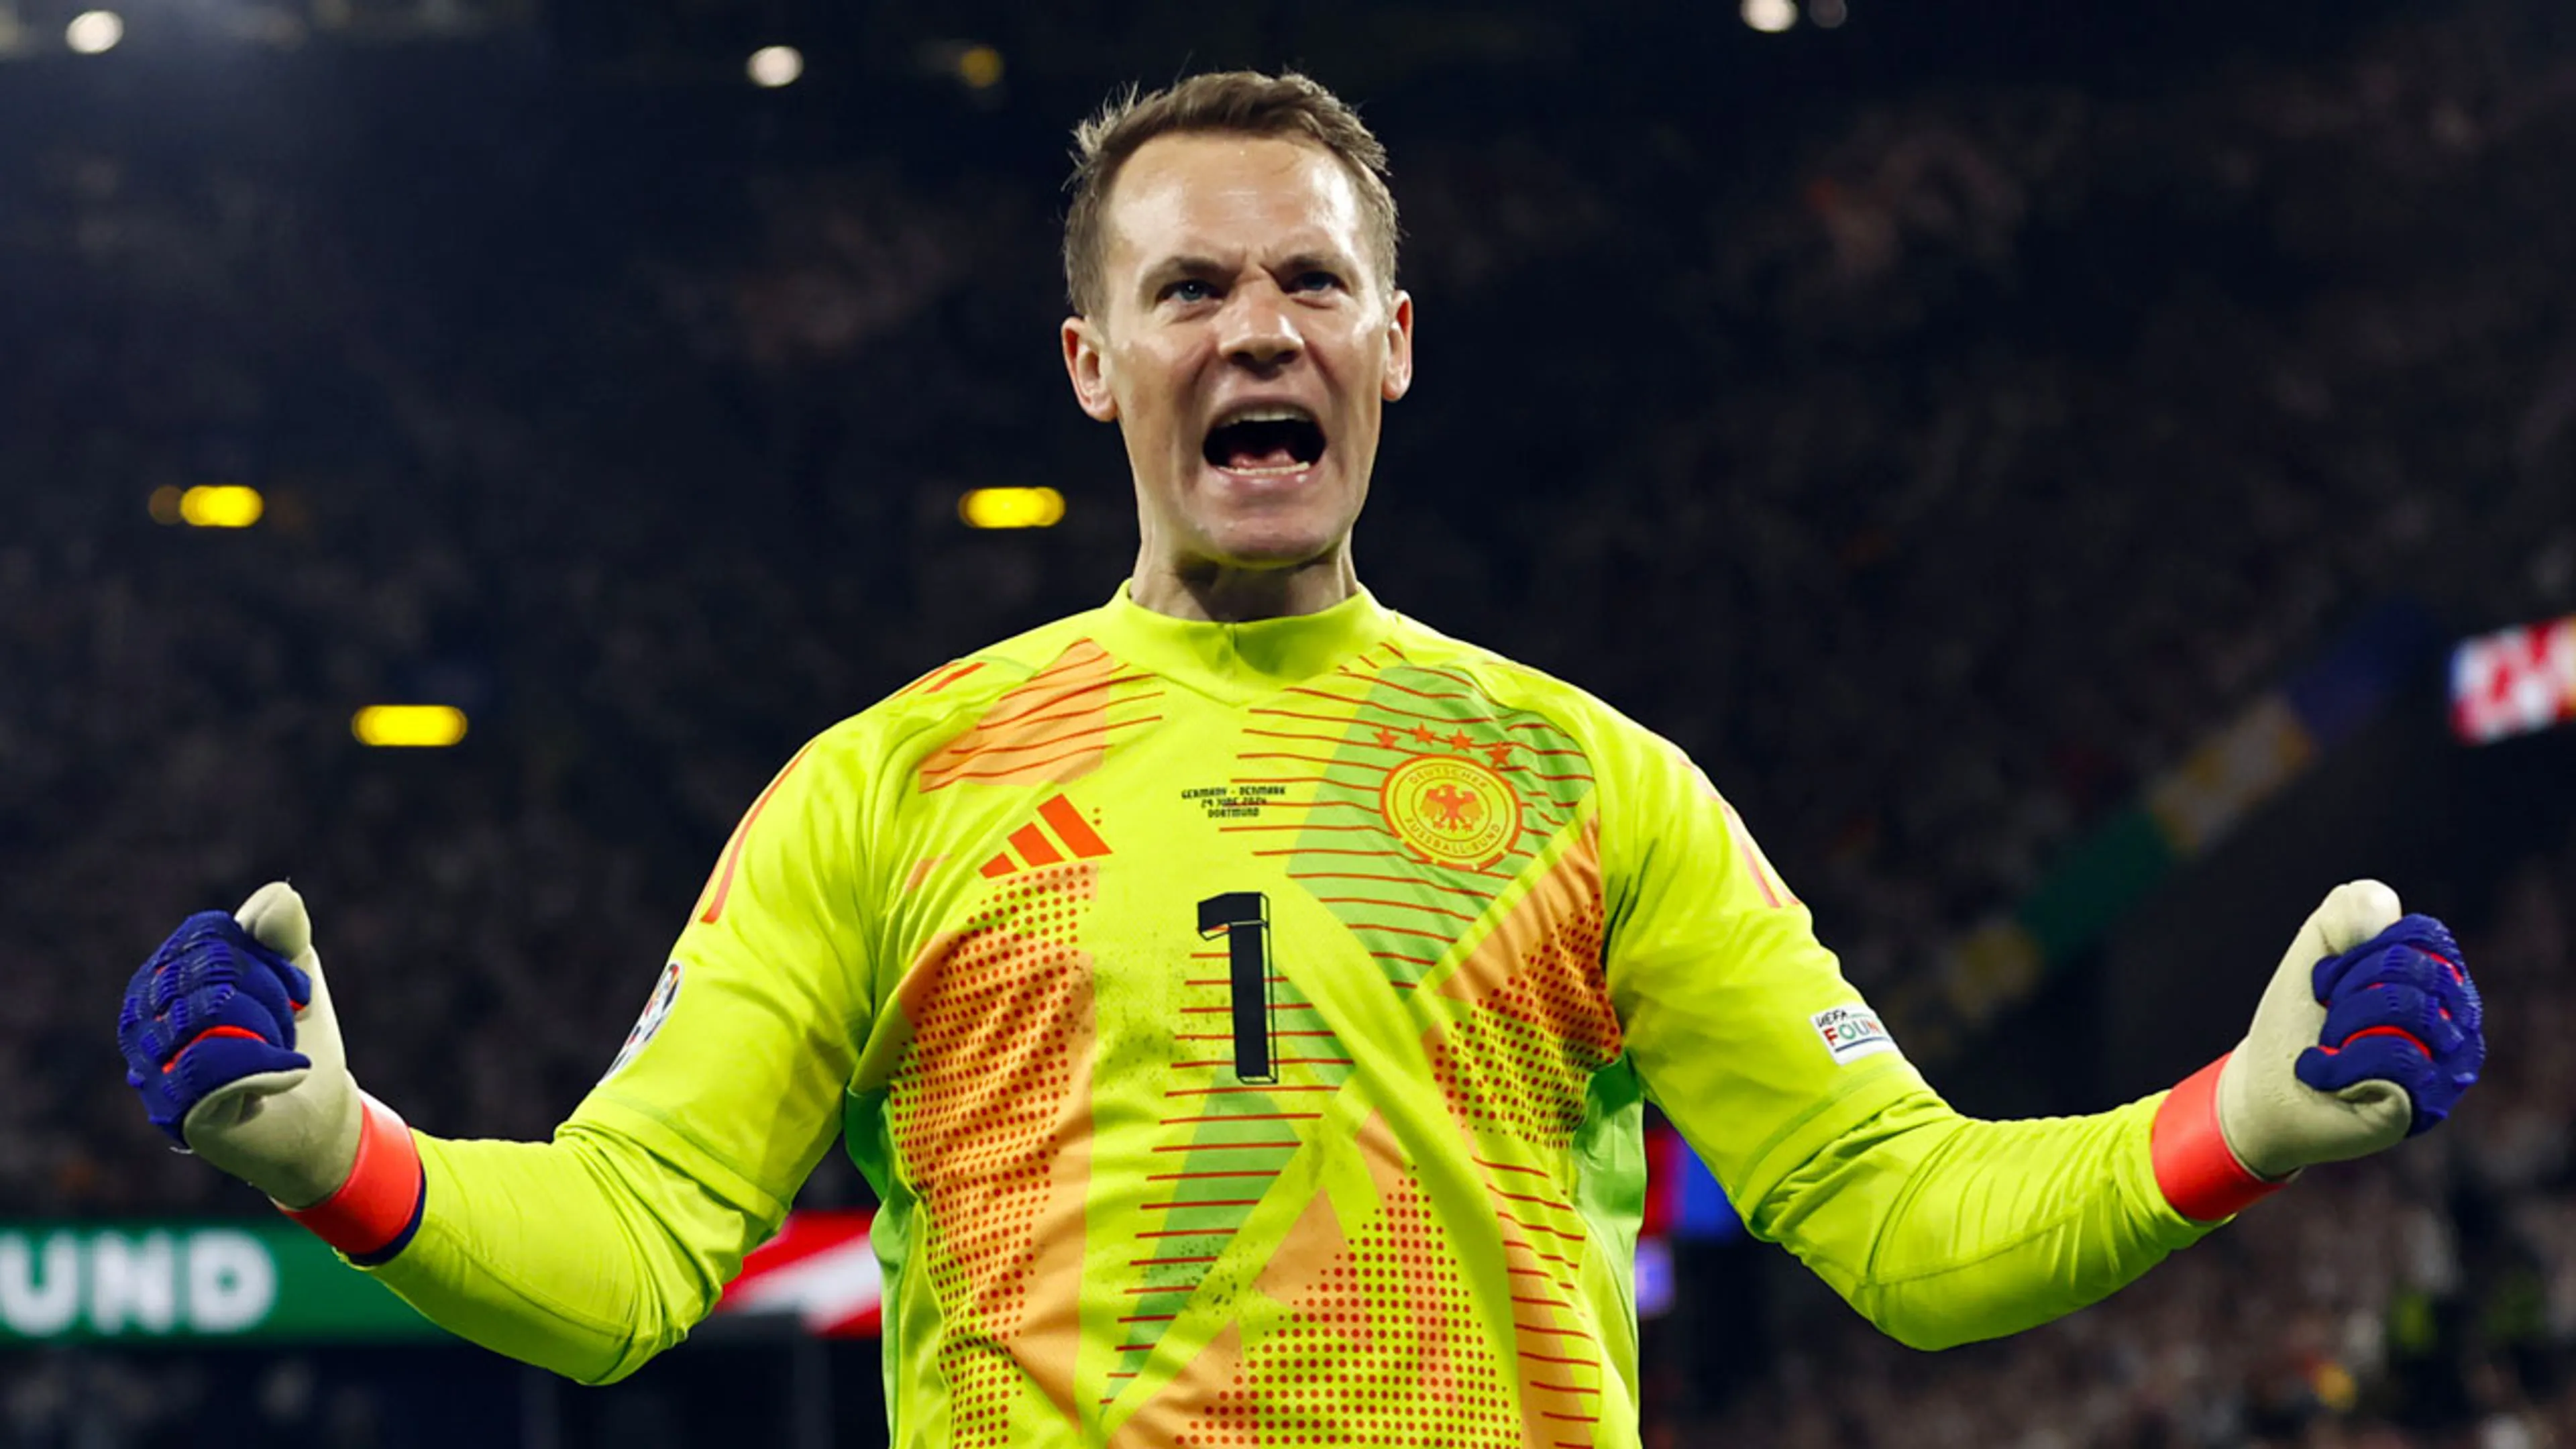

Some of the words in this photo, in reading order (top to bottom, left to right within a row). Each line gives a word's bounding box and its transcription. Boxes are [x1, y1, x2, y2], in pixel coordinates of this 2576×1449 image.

[1181, 788, 1227, 799] GERMANY
[1240, 786, 1285, 796] DENMARK
[1216, 797, 1238, 806] JUNE
[1208, 807, 1259, 817] DORTMUND
[1197, 891, 1278, 1085] 1
[1816, 1010, 1848, 1027] UEFA
[0, 1230, 276, 1335] UND
